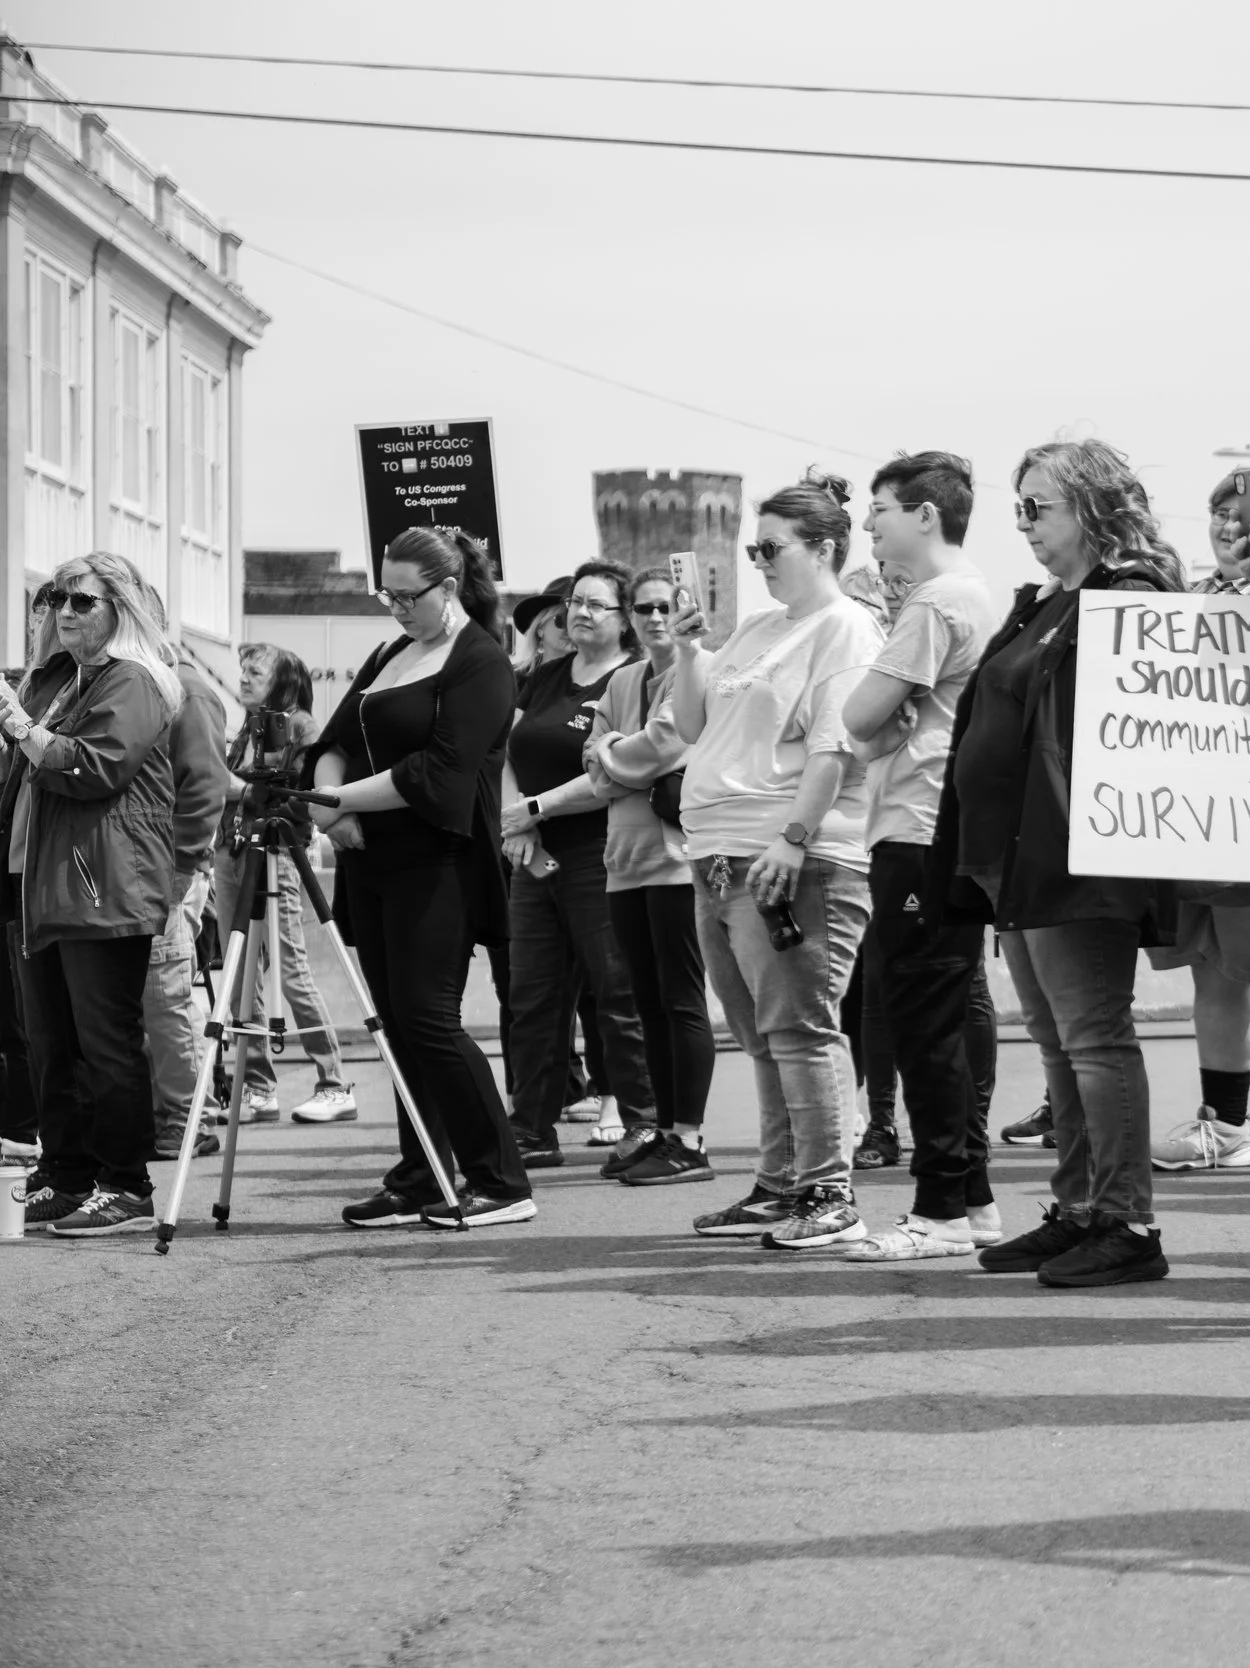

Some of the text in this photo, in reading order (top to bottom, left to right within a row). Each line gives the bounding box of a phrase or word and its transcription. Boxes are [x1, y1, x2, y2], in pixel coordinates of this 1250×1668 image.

[400, 424, 430, 436] TEXT
[381, 454, 473, 472] TO # 50409
[395, 483, 466, 495] To US Congress
[404, 496, 458, 507] Co-Sponsor
